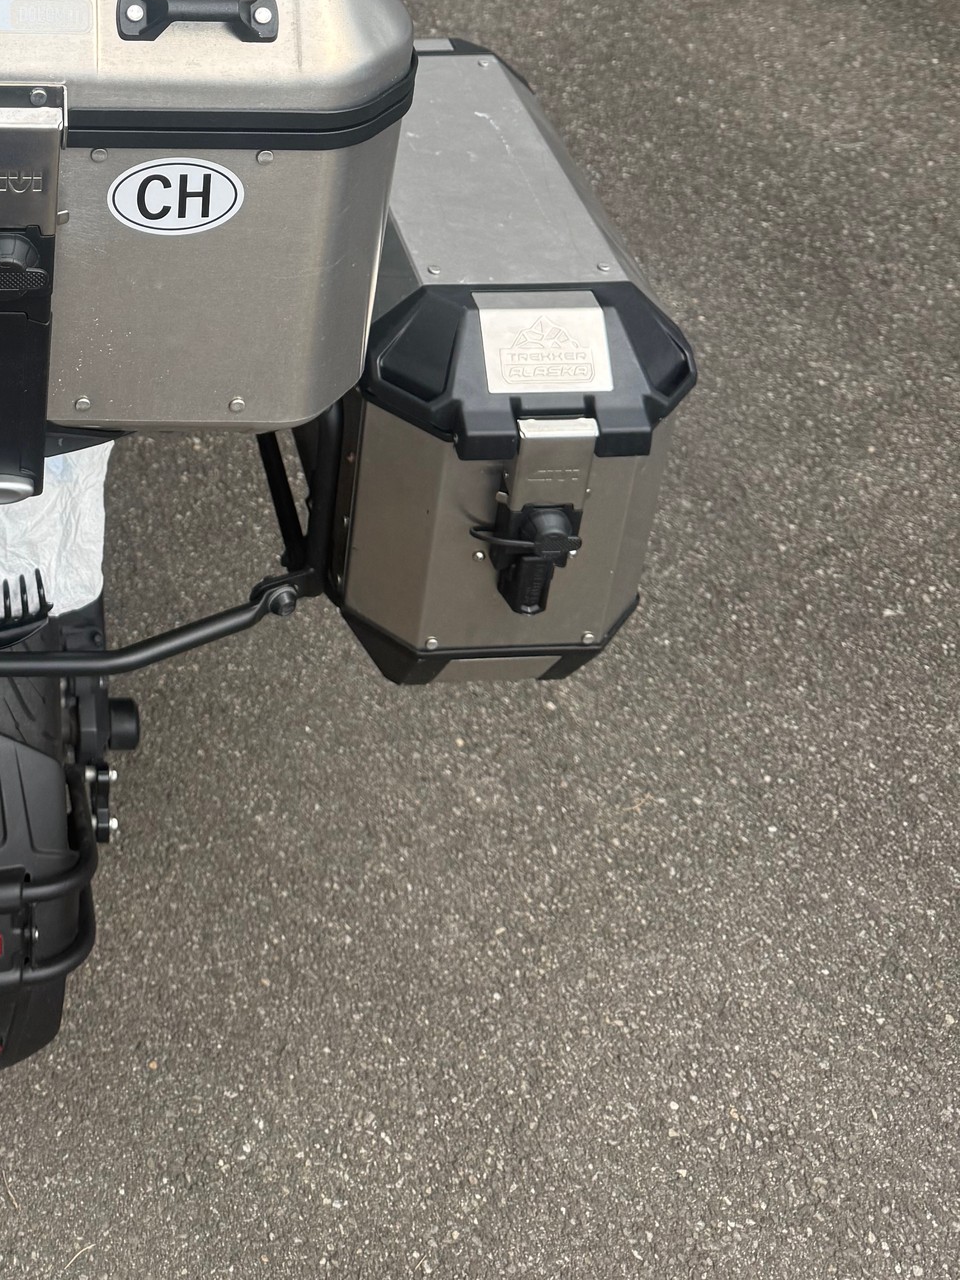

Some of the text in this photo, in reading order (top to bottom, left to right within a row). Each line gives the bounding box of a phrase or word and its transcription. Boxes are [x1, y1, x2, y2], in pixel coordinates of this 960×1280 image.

[136, 173, 212, 222] CH
[506, 351, 588, 362] TREKKER
[507, 365, 589, 378] ALASKA
